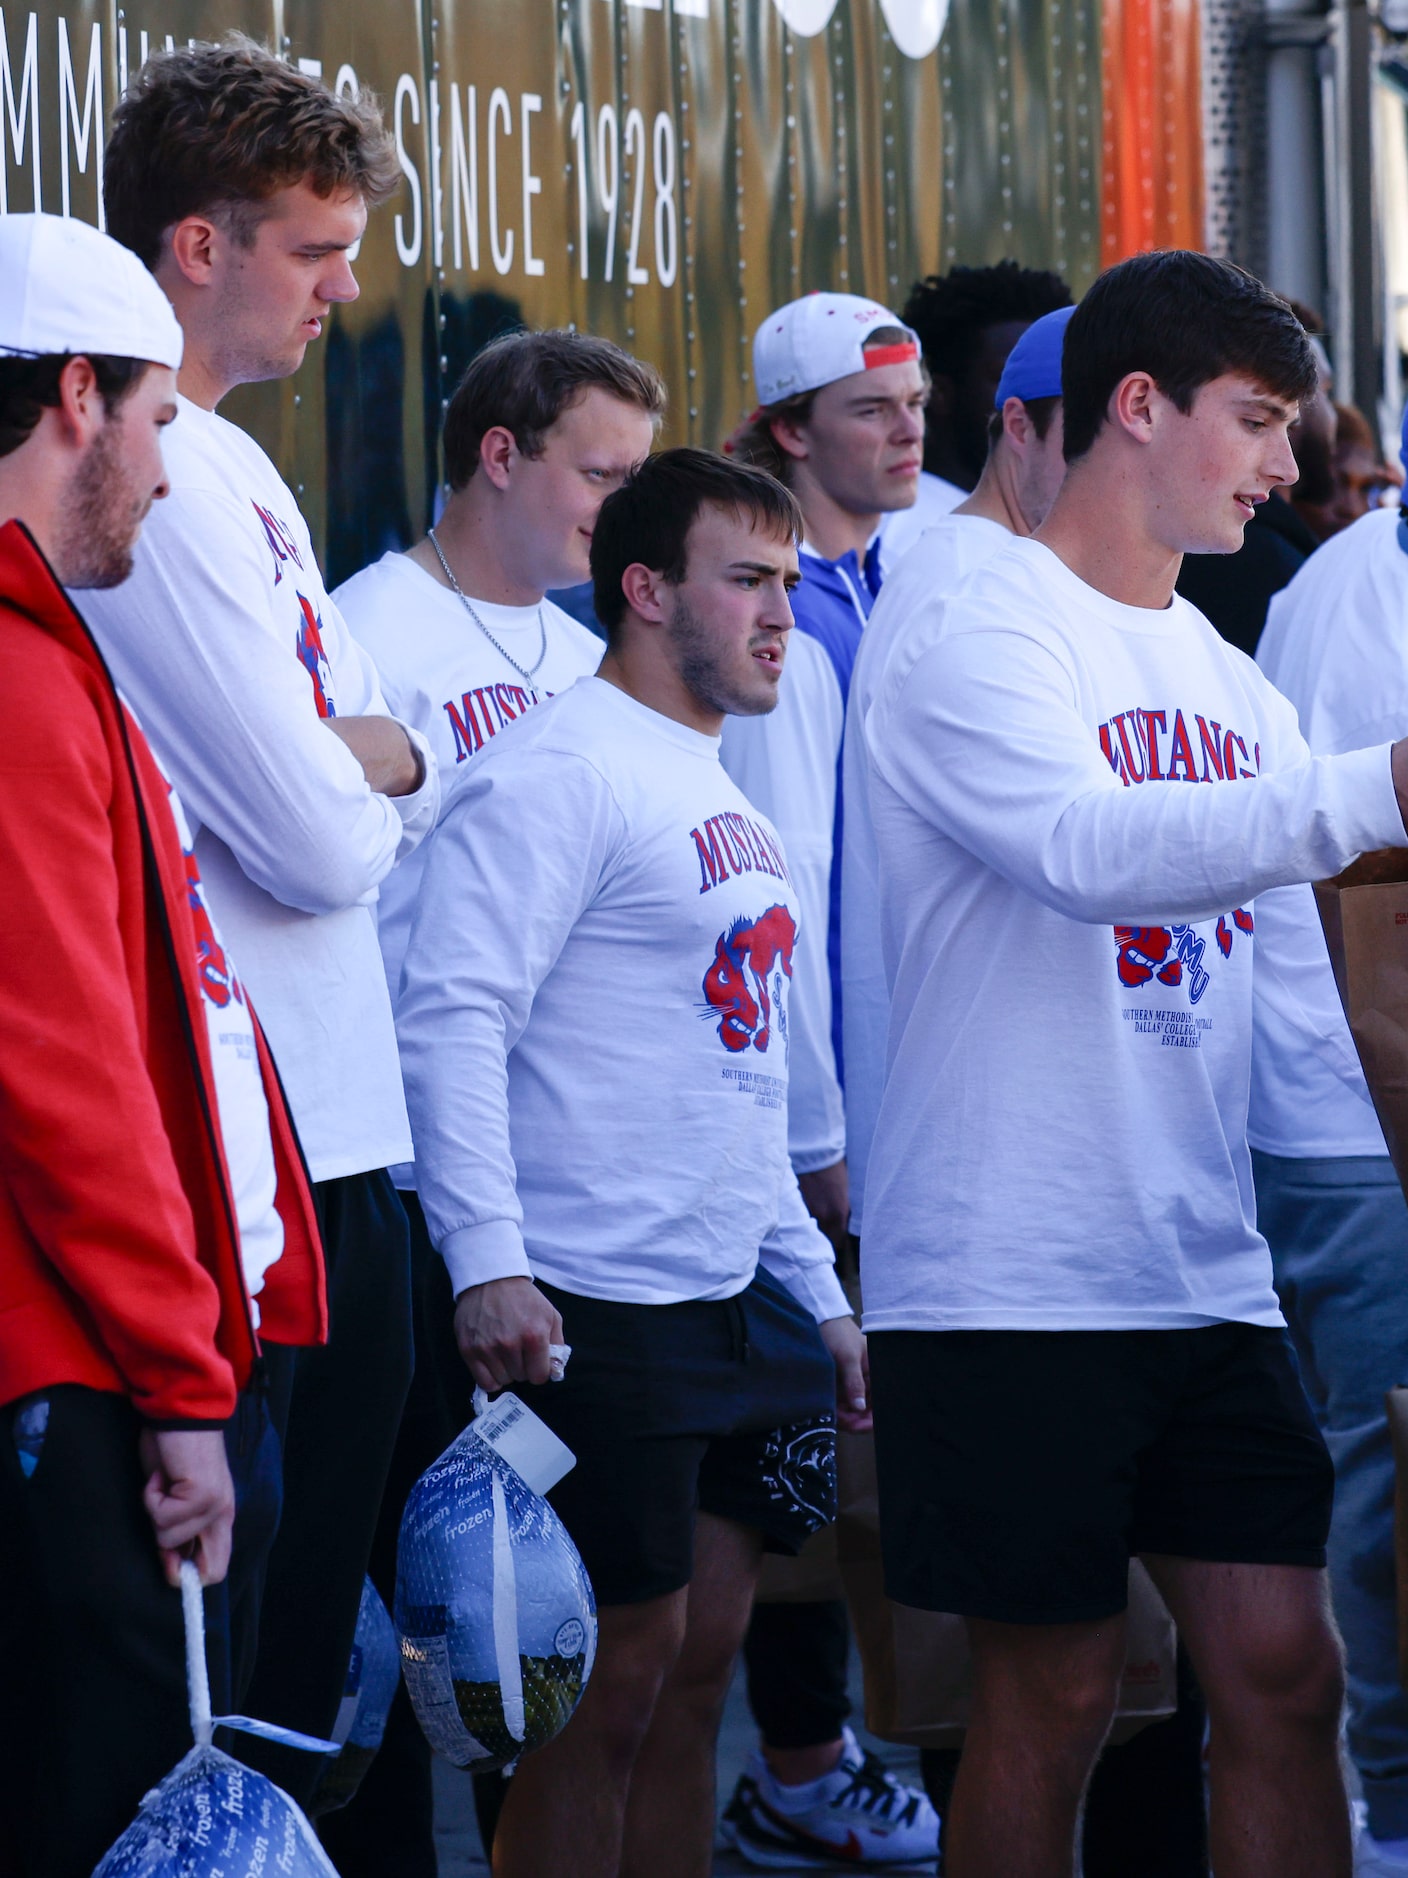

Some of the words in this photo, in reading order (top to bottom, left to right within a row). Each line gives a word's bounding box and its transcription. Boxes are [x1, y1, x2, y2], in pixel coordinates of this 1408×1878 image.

[394, 73, 545, 276] SINCE
[571, 102, 678, 288] 1928
[1098, 707, 1261, 787] MUSTANG
[444, 1507, 494, 1543] frozen
[221, 1770, 244, 1819] froze
